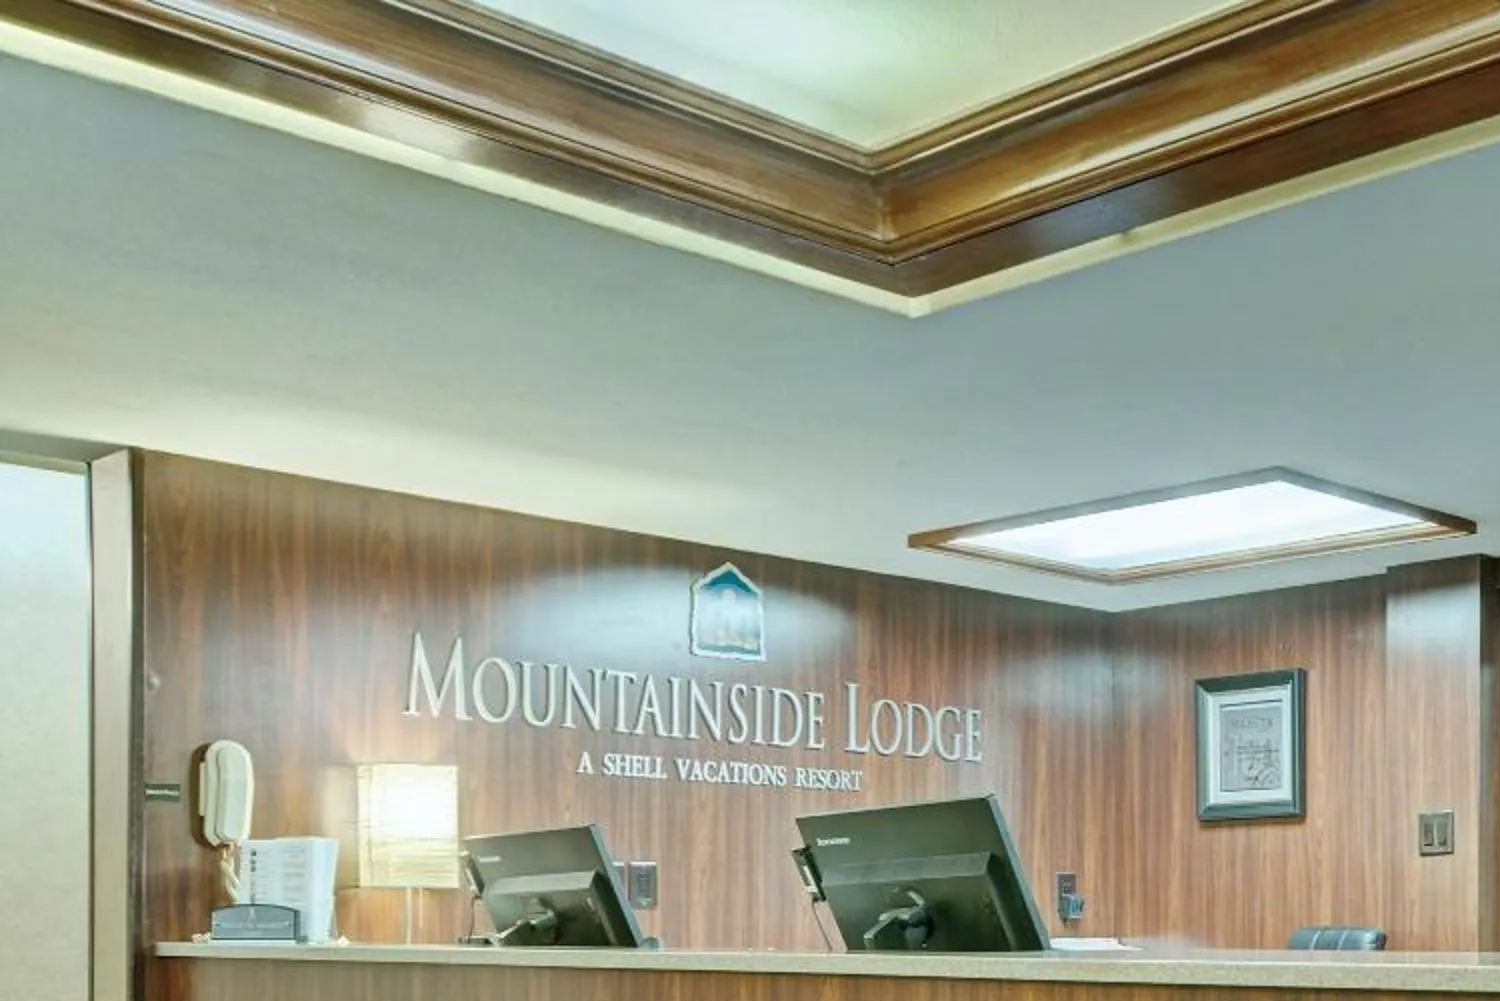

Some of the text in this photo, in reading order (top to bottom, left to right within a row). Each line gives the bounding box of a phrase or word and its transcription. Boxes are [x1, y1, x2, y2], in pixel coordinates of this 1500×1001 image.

[401, 632, 982, 762] MOUNTAINSIDE LODGE
[576, 751, 863, 791] A SHELL VACATIONS RESORT
